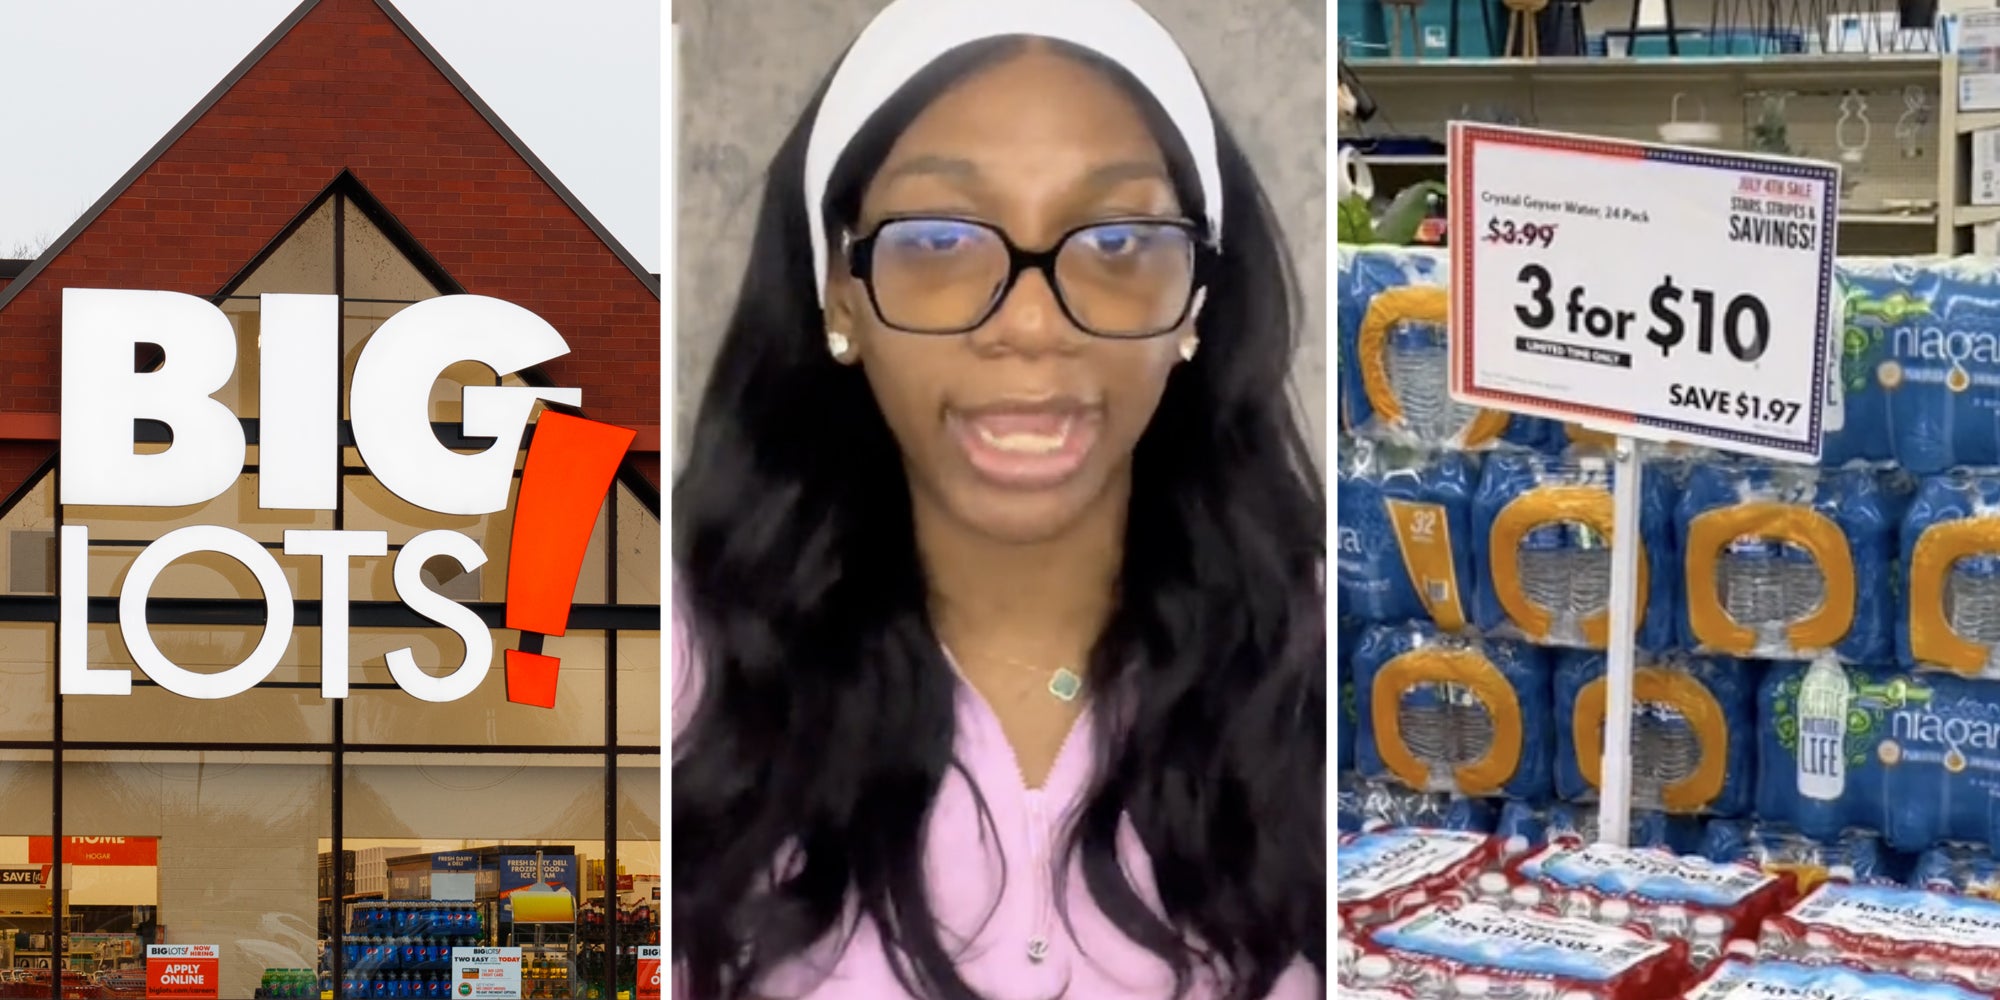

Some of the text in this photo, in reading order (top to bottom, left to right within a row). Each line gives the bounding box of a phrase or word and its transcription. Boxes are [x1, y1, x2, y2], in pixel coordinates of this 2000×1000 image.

[1738, 176, 1762, 192] JULY
[1786, 181, 1813, 197] SALE
[1481, 191, 1649, 222] Crystal Geyser Water, 24 Pack
[1766, 200, 1805, 219] STRIPES
[1808, 206, 1816, 220] &
[1487, 215, 1555, 249] $3.99
[1728, 214, 1816, 251] SAVINGS!
[1514, 263, 1770, 363] 3 for $10
[1591, 351, 1620, 364] ONLY
[61, 288, 582, 515] BIG
[1668, 383, 1802, 425] SAVE $1.97
[1409, 510, 1437, 535] 32
[1801, 734, 1839, 778] LIFE
[2, 872, 31, 882] SAVE
[151, 947, 167, 955] BIG
[160, 974, 205, 985] ONLINE
[165, 964, 200, 974] APPLY
